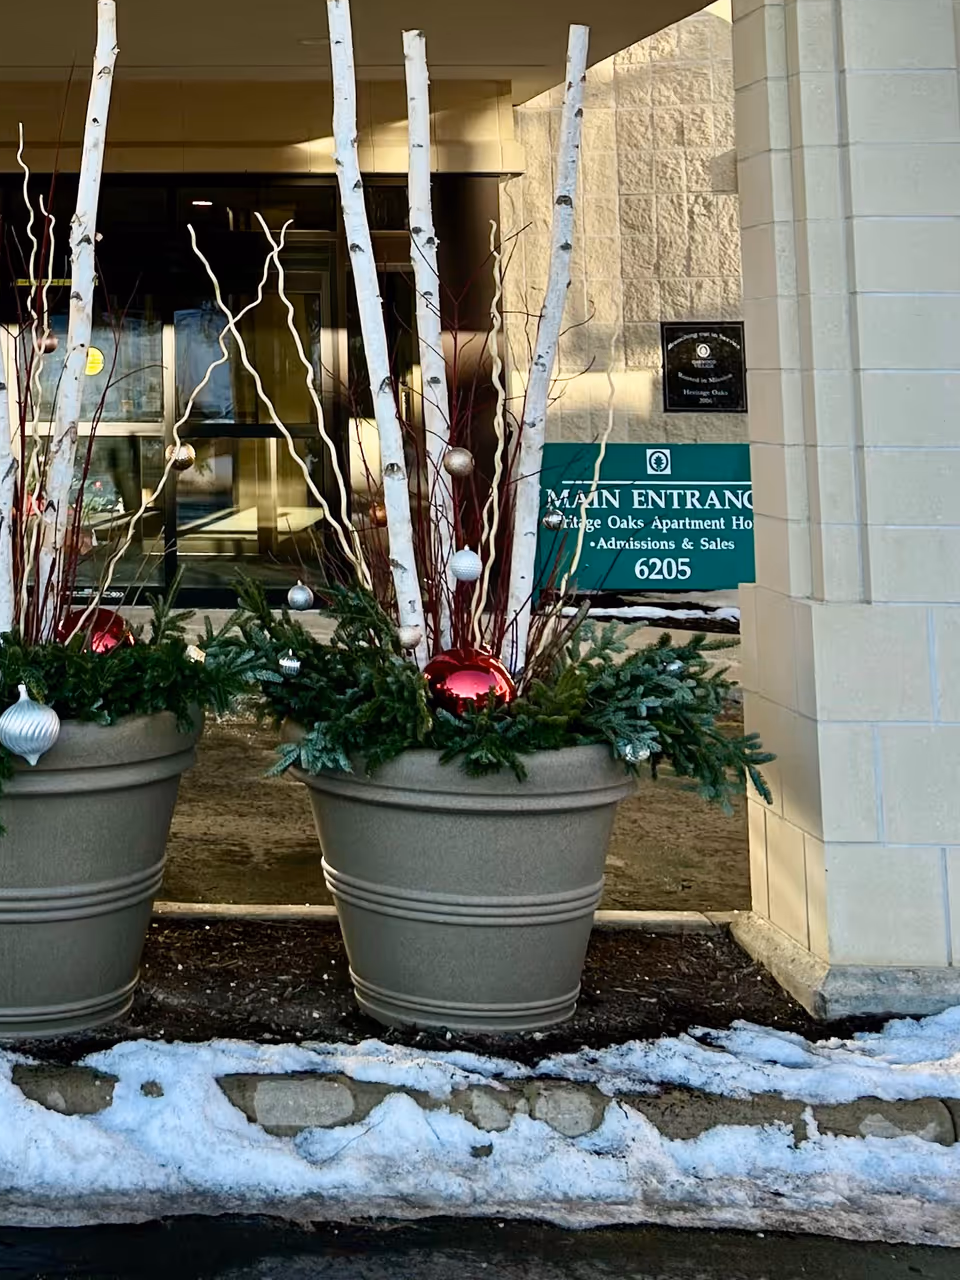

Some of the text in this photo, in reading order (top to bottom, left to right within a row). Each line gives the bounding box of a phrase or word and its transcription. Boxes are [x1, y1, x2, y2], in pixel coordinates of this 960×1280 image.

[545, 488, 754, 510] MAIN ENTRANC
[607, 514, 645, 530] Oaks
[650, 515, 726, 534] Apartment
[681, 537, 694, 550] &
[700, 536, 736, 550] Sales
[634, 556, 692, 580] 6205
